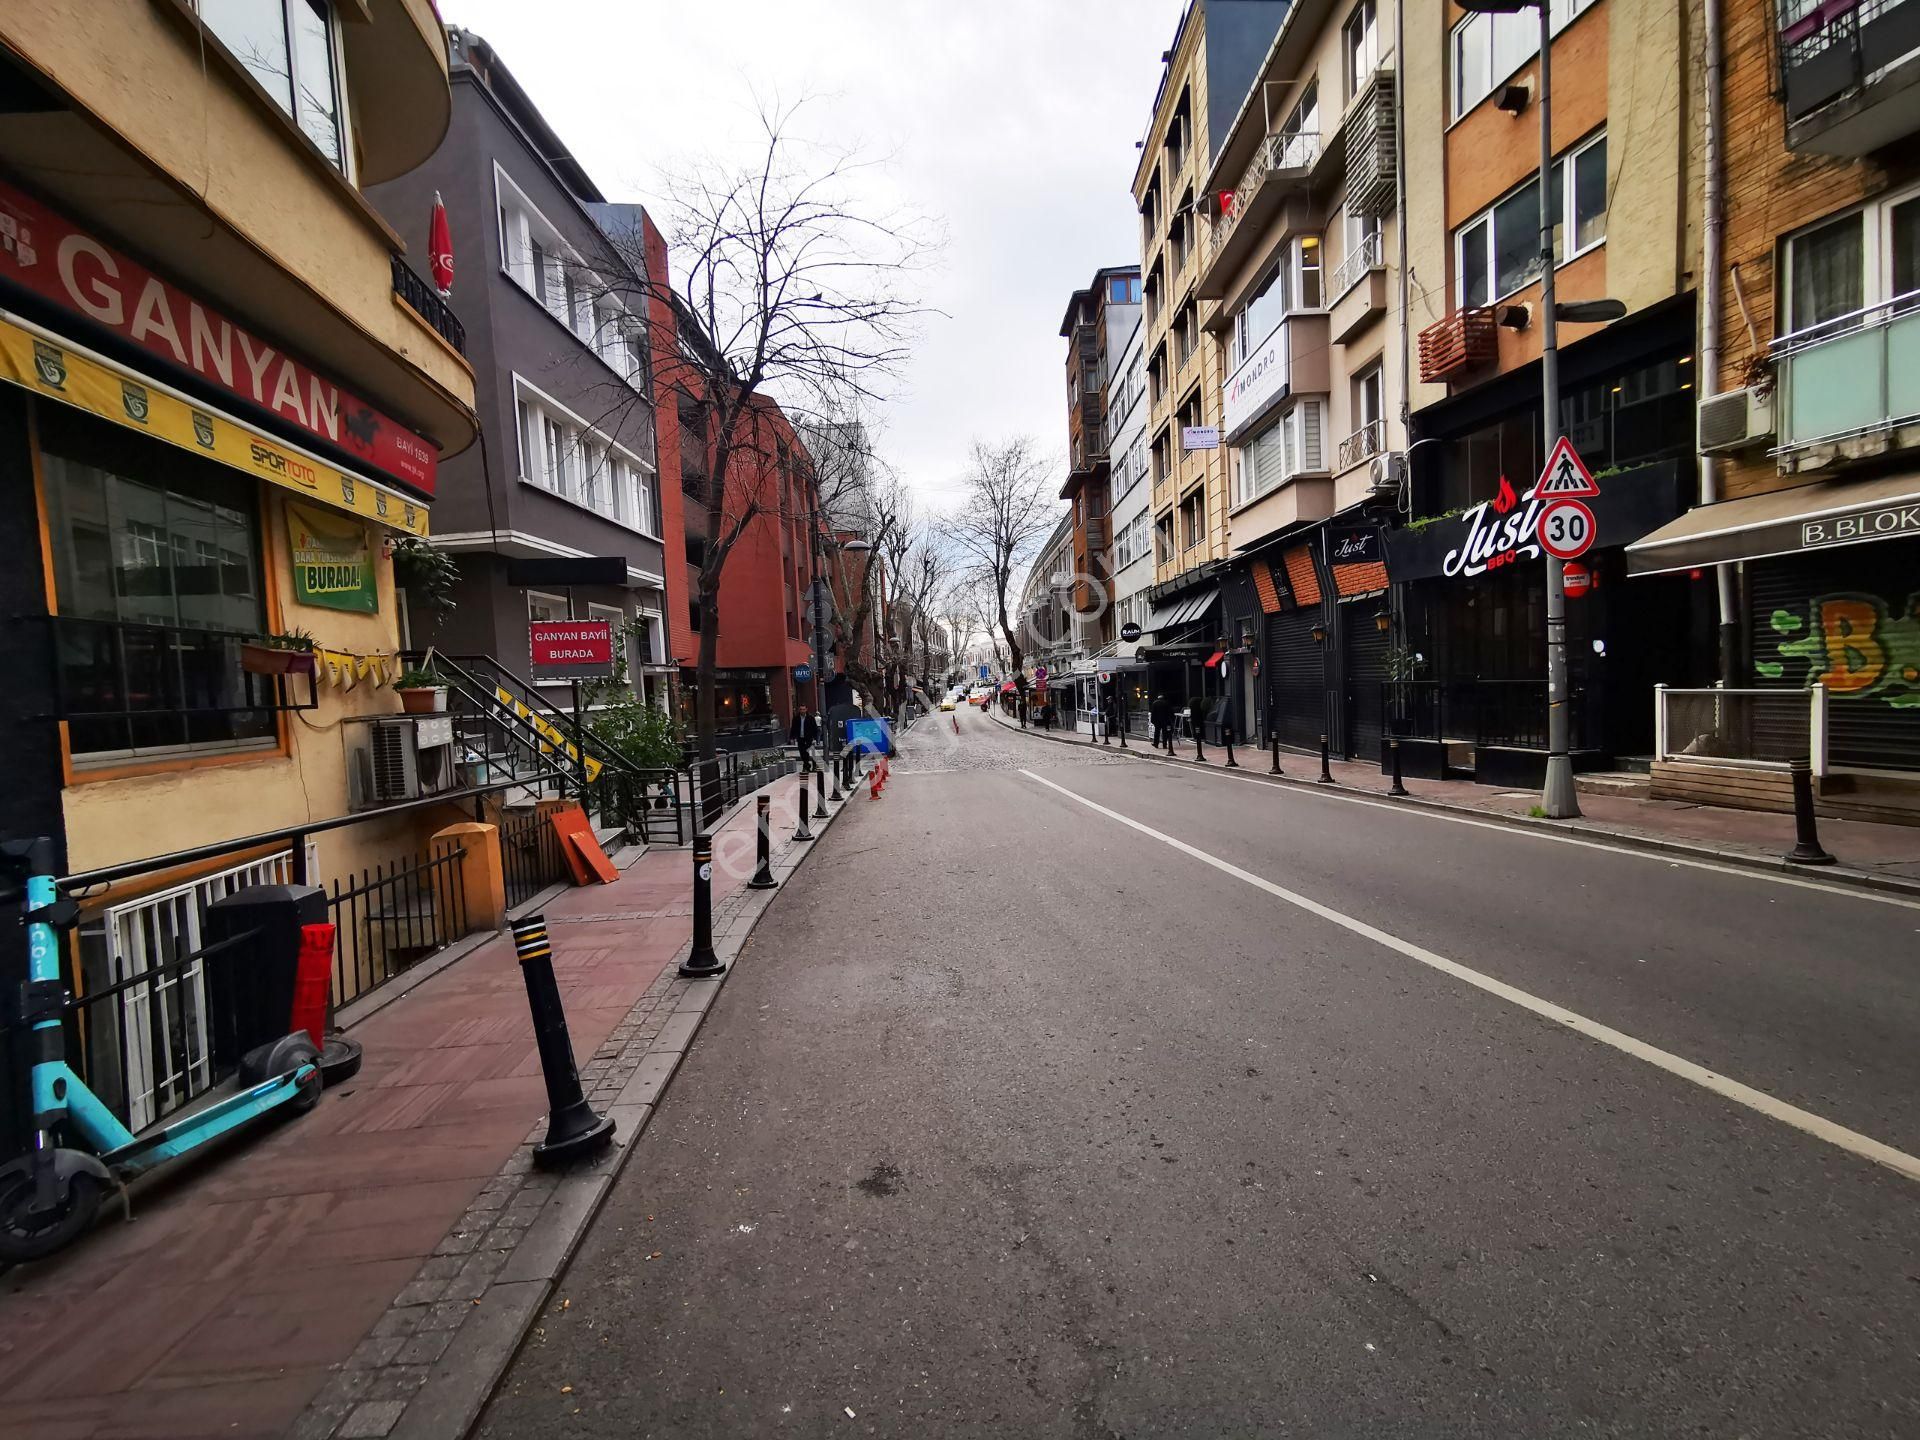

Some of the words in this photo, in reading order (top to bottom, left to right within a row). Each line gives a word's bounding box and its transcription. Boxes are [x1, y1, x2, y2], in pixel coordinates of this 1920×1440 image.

[57, 234, 338, 441] GANYAN
[250, 443, 316, 483] SPORTOTO
[1442, 488, 1546, 577] Just
[1550, 515, 1584, 541] 30
[1805, 507, 1920, 544] B.BLOK
[1334, 534, 1373, 557] Just
[1487, 550, 1516, 570] BBQ
[307, 565, 361, 590] BURADA!
[535, 632, 578, 641] GANYAN
[549, 649, 594, 659] BURADA
